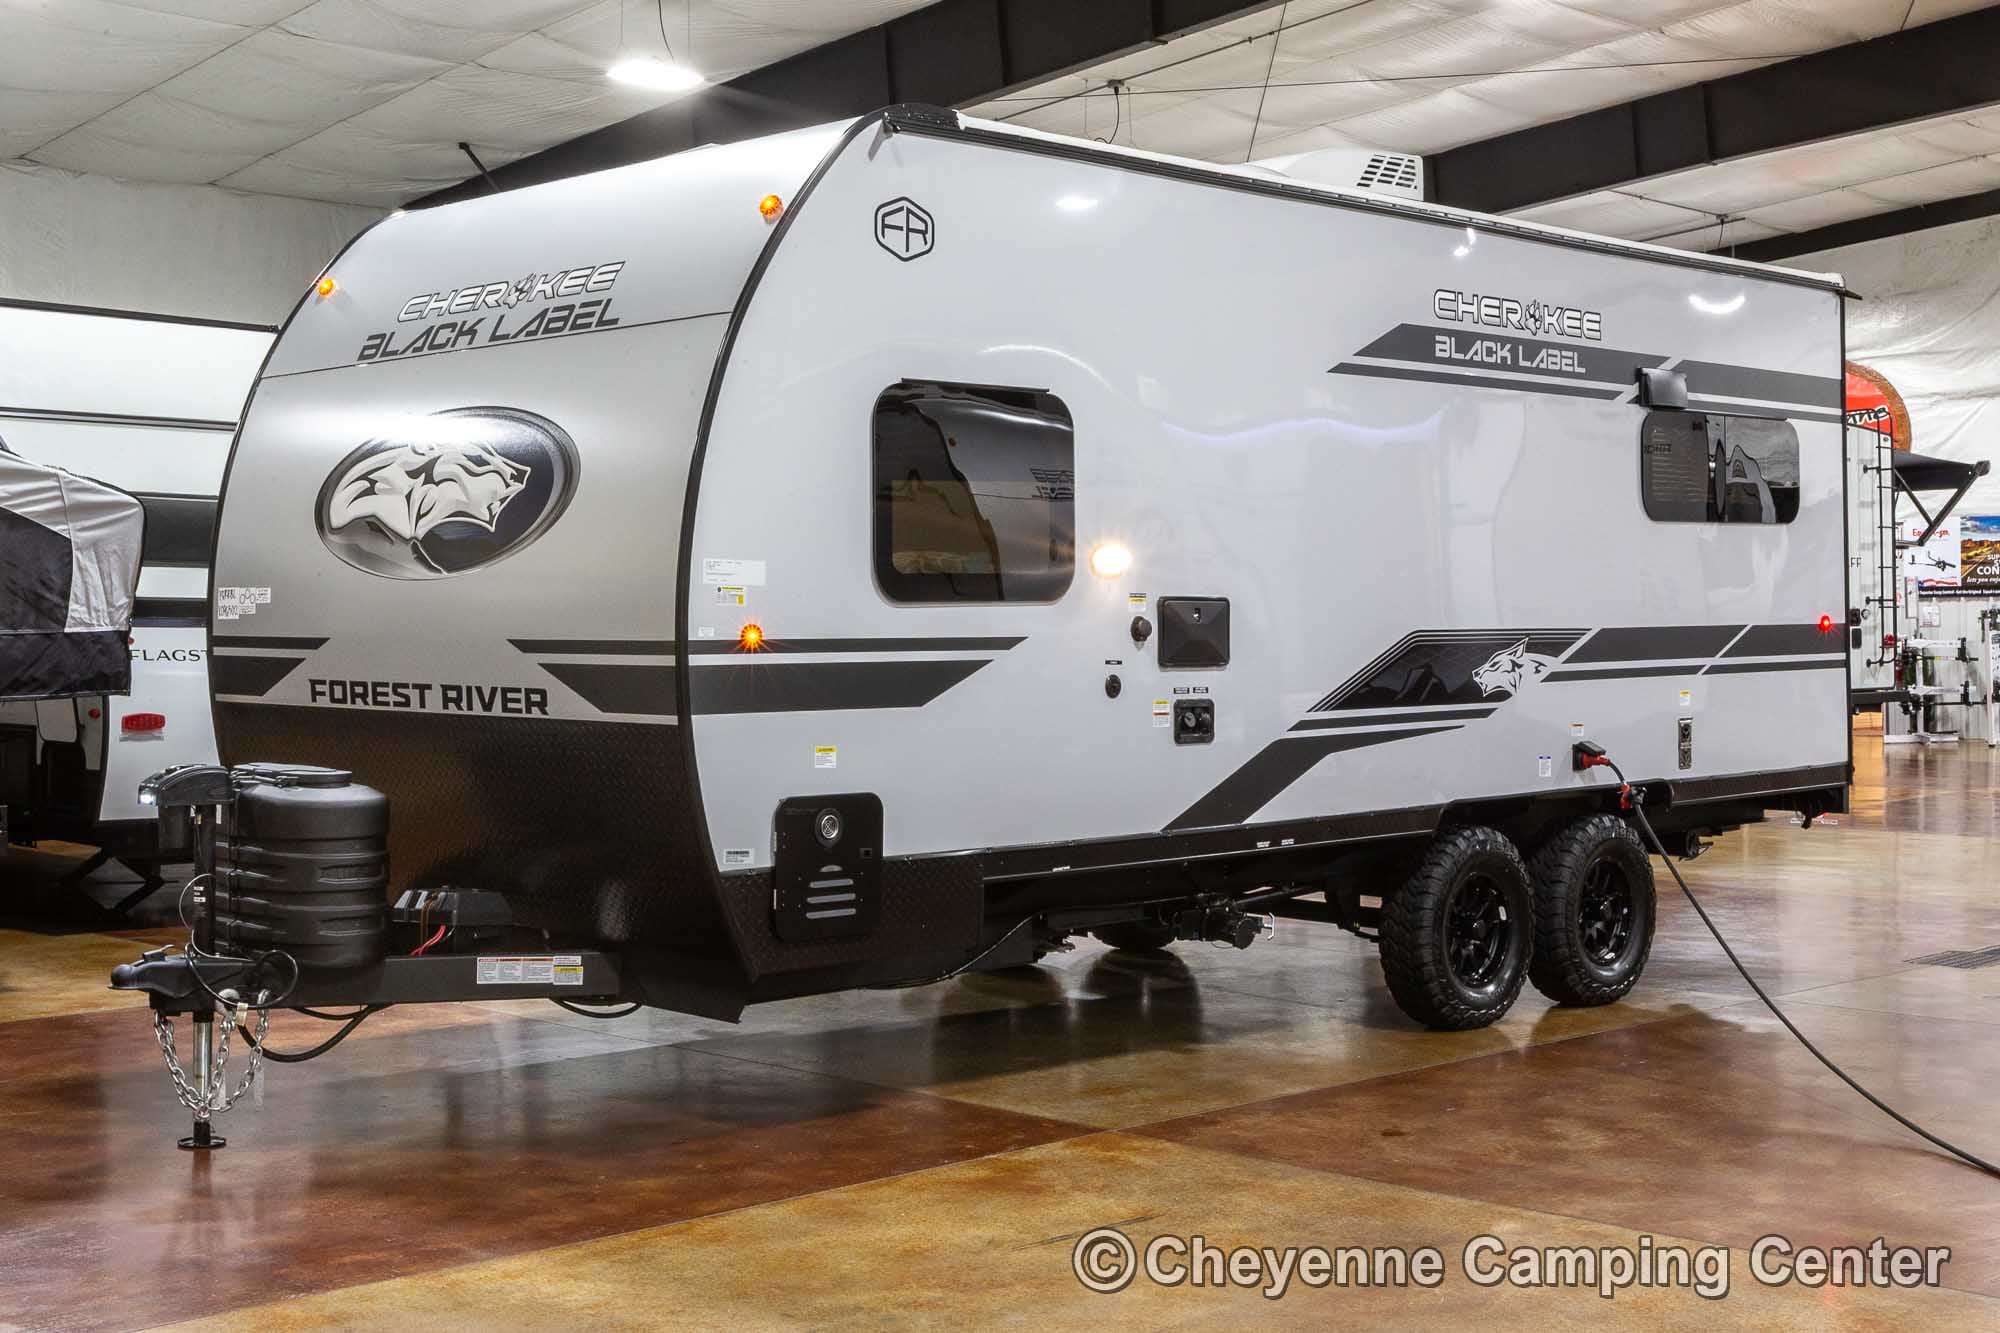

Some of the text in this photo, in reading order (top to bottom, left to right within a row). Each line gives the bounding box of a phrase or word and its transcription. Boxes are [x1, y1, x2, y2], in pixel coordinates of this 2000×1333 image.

[356, 298, 620, 362] BLACK LABEL
[1435, 335, 1586, 374] BLACK LABEL
[308, 679, 550, 716] FOREST RIVER
